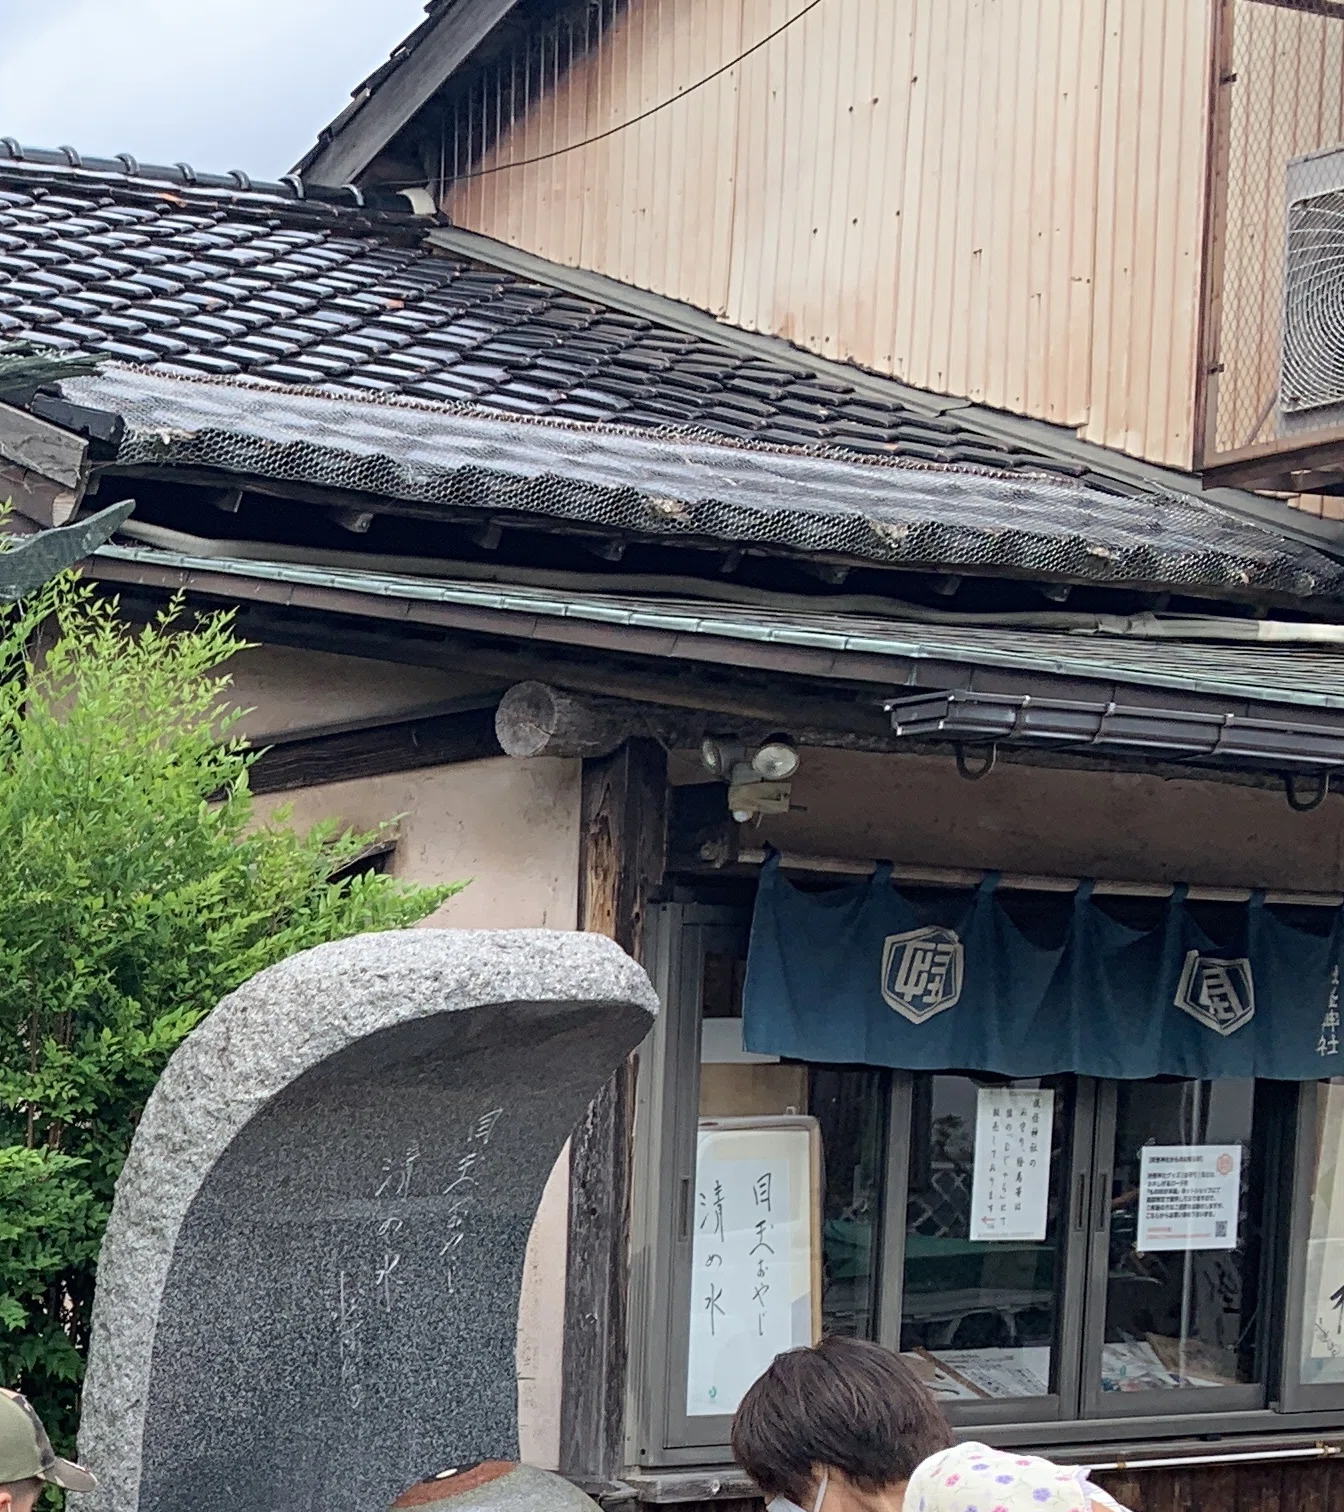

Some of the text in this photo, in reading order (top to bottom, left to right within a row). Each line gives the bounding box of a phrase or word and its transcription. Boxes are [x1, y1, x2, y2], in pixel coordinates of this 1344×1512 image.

[749, 1172, 775, 1337] 目玉おやじ
